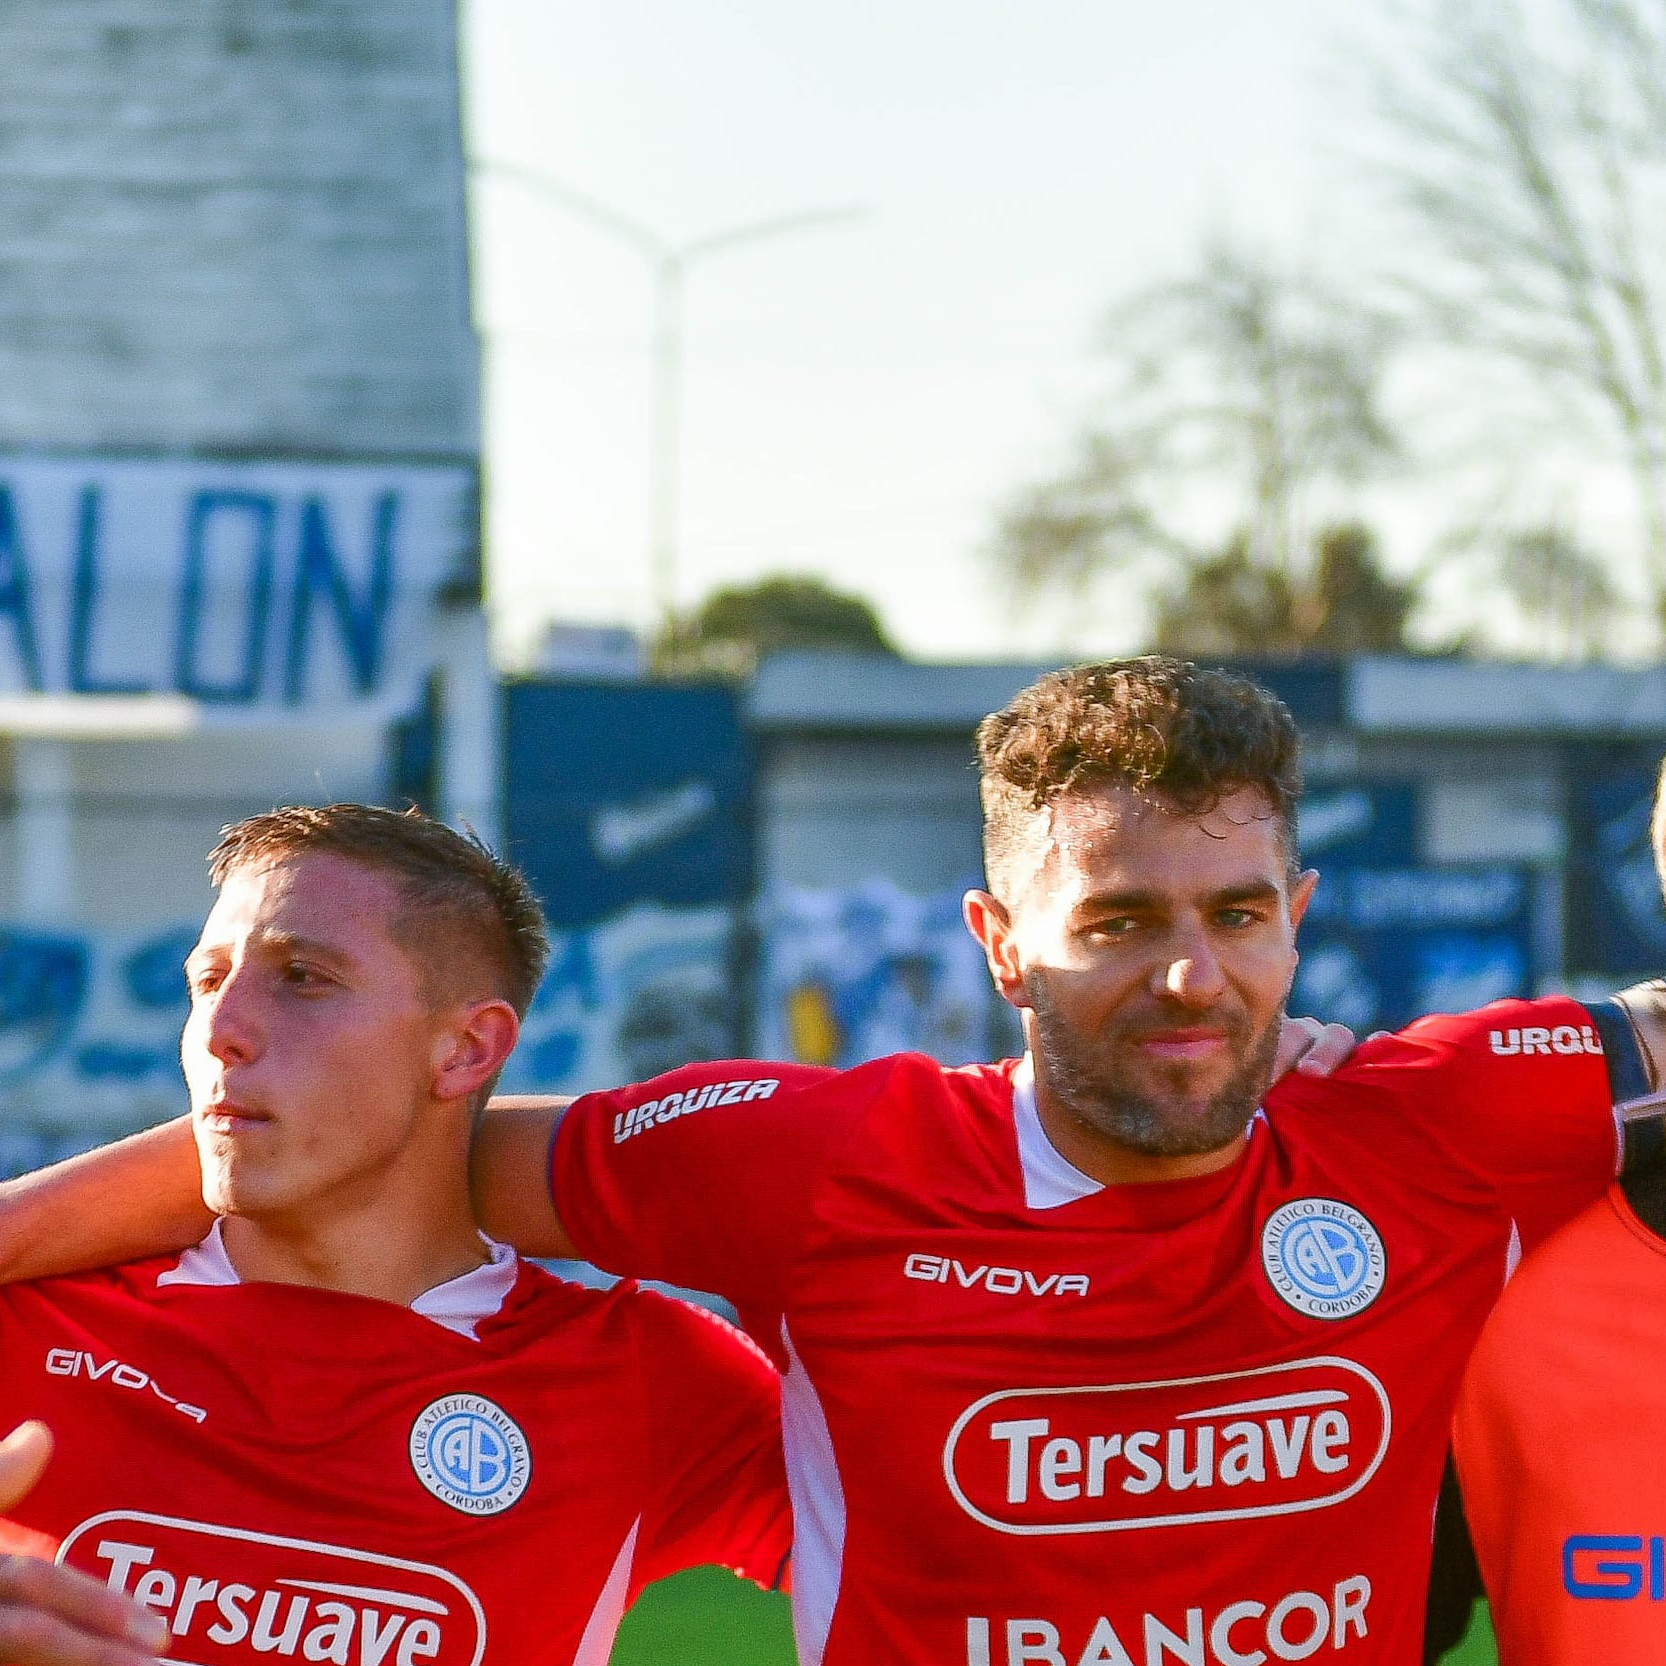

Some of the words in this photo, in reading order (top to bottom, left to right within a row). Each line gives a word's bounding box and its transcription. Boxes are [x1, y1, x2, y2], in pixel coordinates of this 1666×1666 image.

[613, 1079, 780, 1144] URQUIZA
[904, 1253, 1089, 1298] GIVOVA
[1308, 1283, 1377, 1314] CORDOBA
[45, 1346, 207, 1425] GIVOVA
[989, 1408, 1351, 1505] Tersuave
